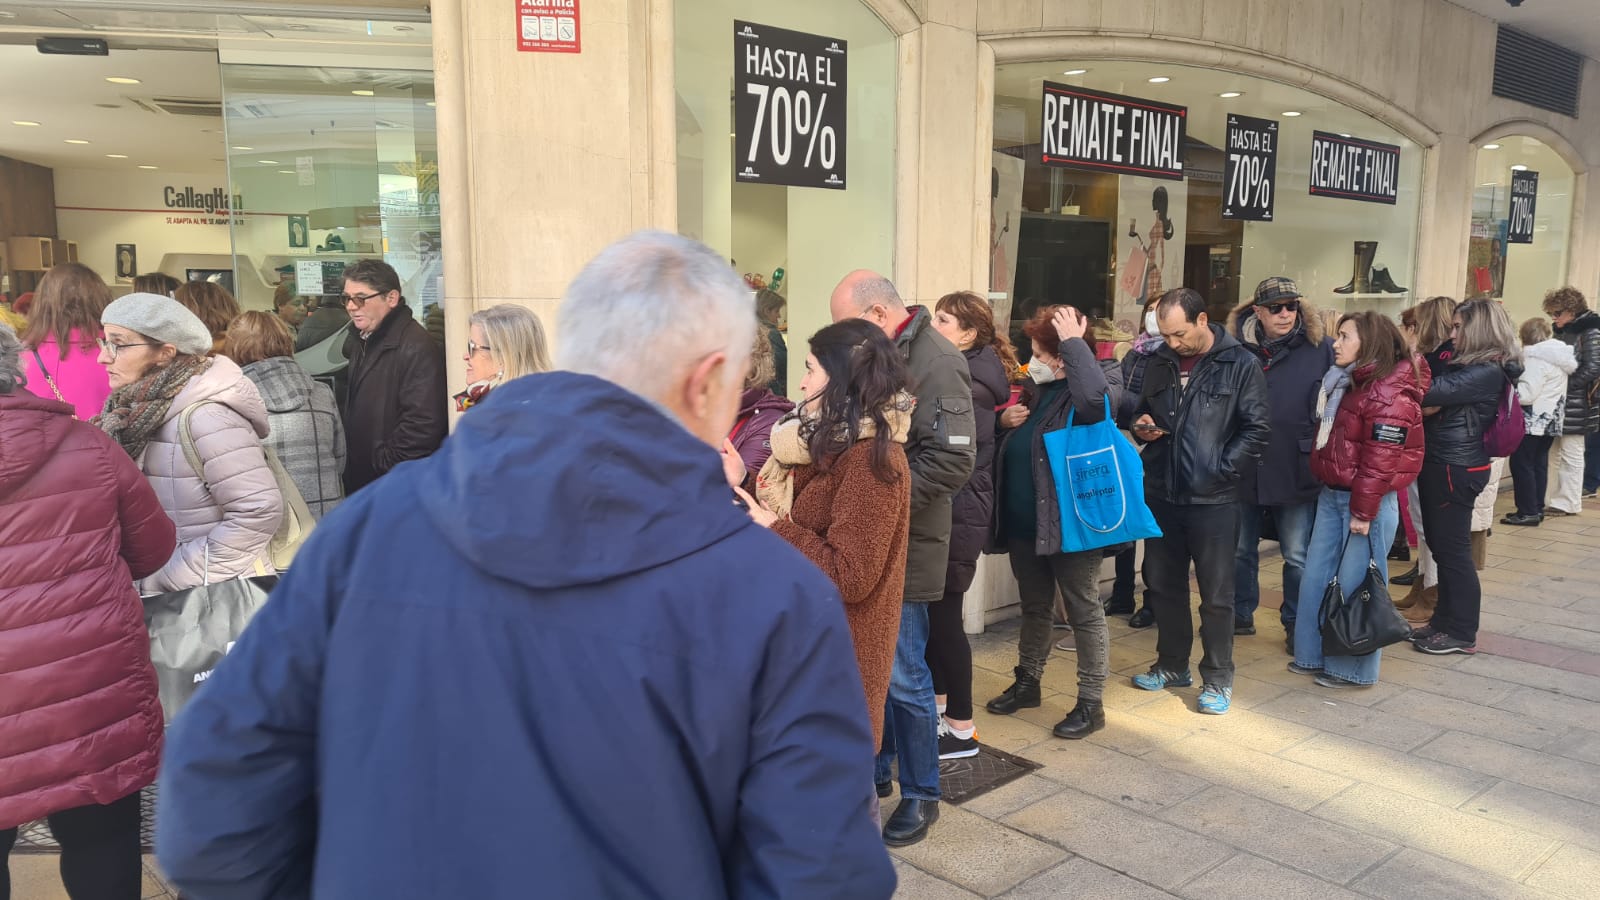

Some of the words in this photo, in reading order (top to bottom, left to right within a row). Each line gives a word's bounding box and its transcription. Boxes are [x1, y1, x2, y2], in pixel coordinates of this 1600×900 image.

[746, 43, 810, 83] HASTA
[815, 55, 837, 87] EL
[747, 82, 836, 170] 70%
[1043, 93, 1125, 162] REMATE
[1129, 108, 1183, 170] FINAL
[1230, 127, 1260, 151] HASTA
[1262, 132, 1273, 153] EL
[1228, 153, 1270, 208] 70%
[1311, 140, 1362, 191] REMATE
[1363, 149, 1397, 196] FINAL
[1512, 179, 1529, 193] HASTA
[1529, 180, 1535, 195] EL
[1509, 196, 1533, 234] 70%
